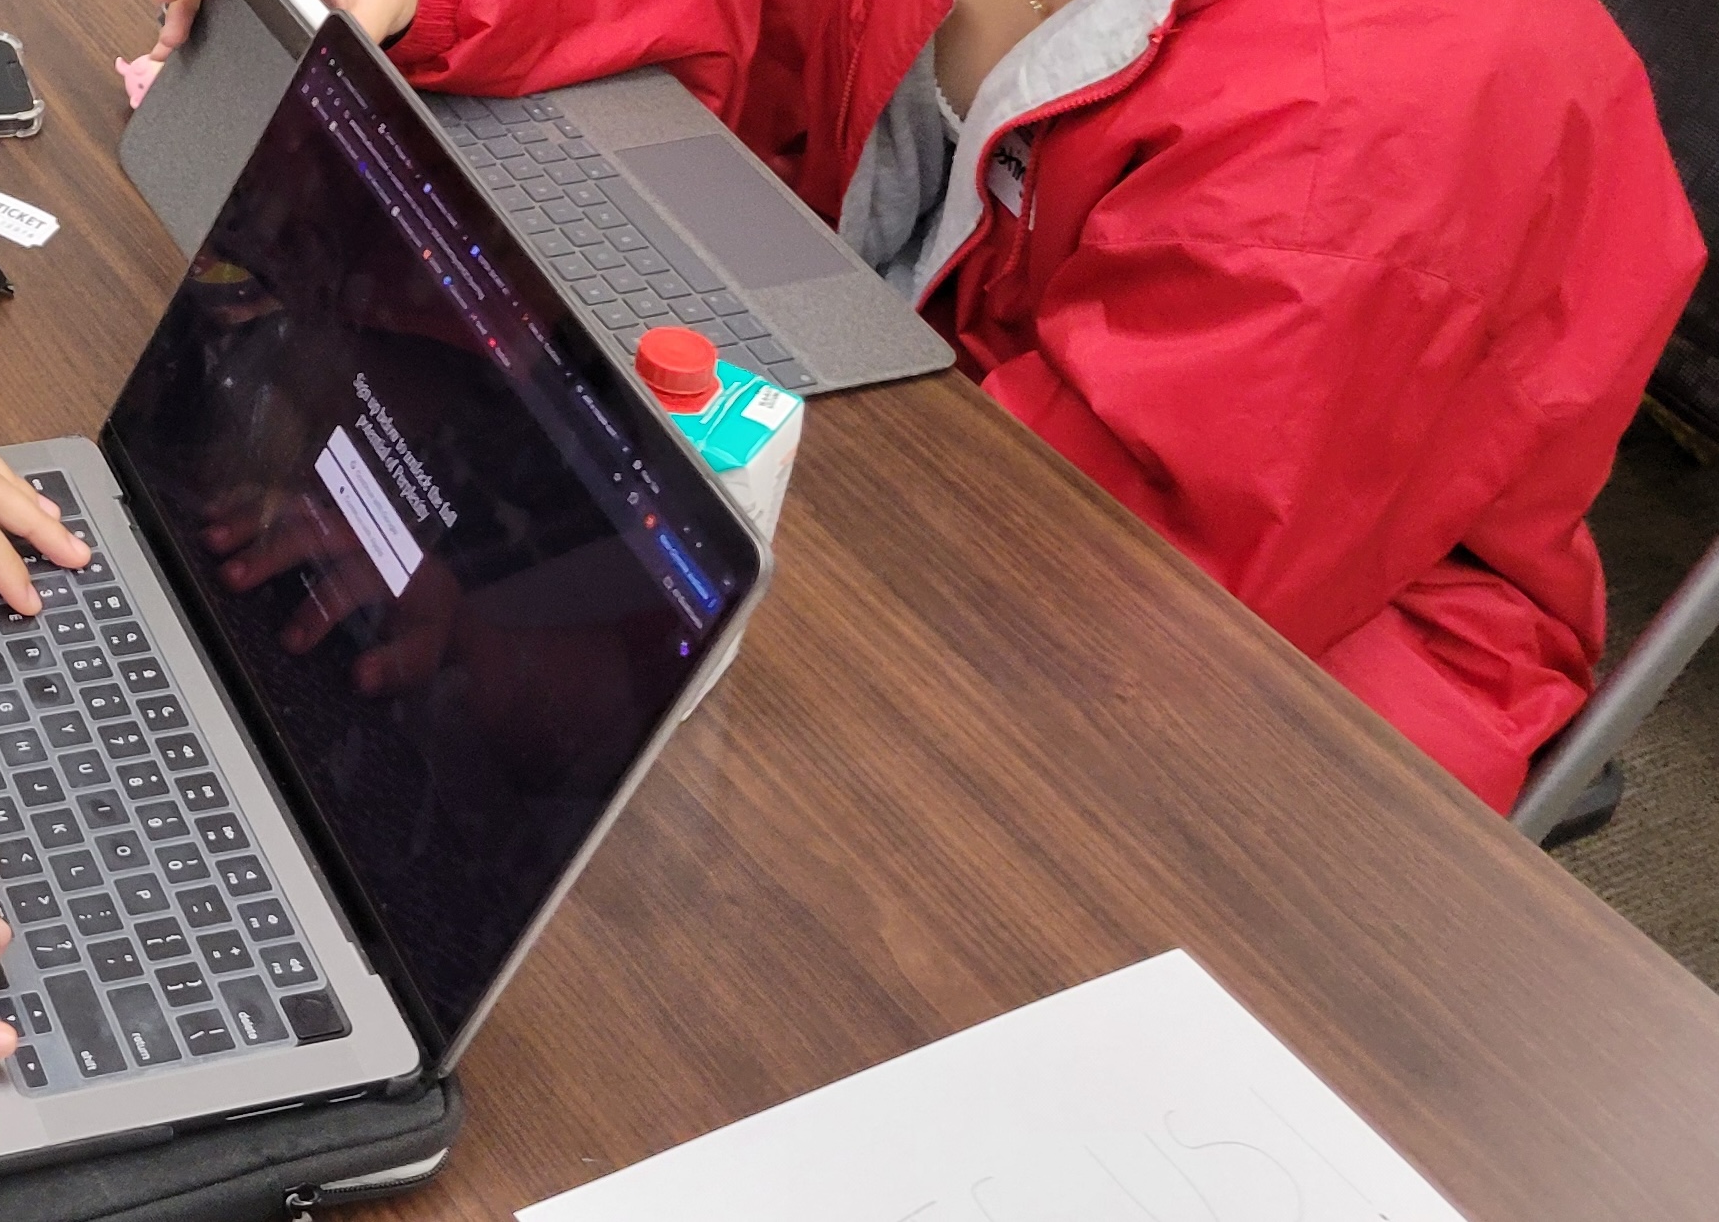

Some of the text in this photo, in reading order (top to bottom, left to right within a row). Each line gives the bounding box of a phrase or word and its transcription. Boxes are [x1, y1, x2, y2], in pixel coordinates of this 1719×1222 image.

[8, 613, 23, 621] E
[25, 648, 40, 657] R
[43, 684, 58, 693] T
[0, 702, 14, 712] G
[61, 724, 76, 733] Y
[16, 741, 31, 752] H
[78, 763, 94, 774] U
[33, 783, 48, 791] J
[51, 823, 67, 834] K
[116, 846, 131, 856] O
[70, 866, 85, 876] L
[136, 889, 152, 899] P
[238, 1011, 258, 1040] delete
[131, 1032, 151, 1061] return
